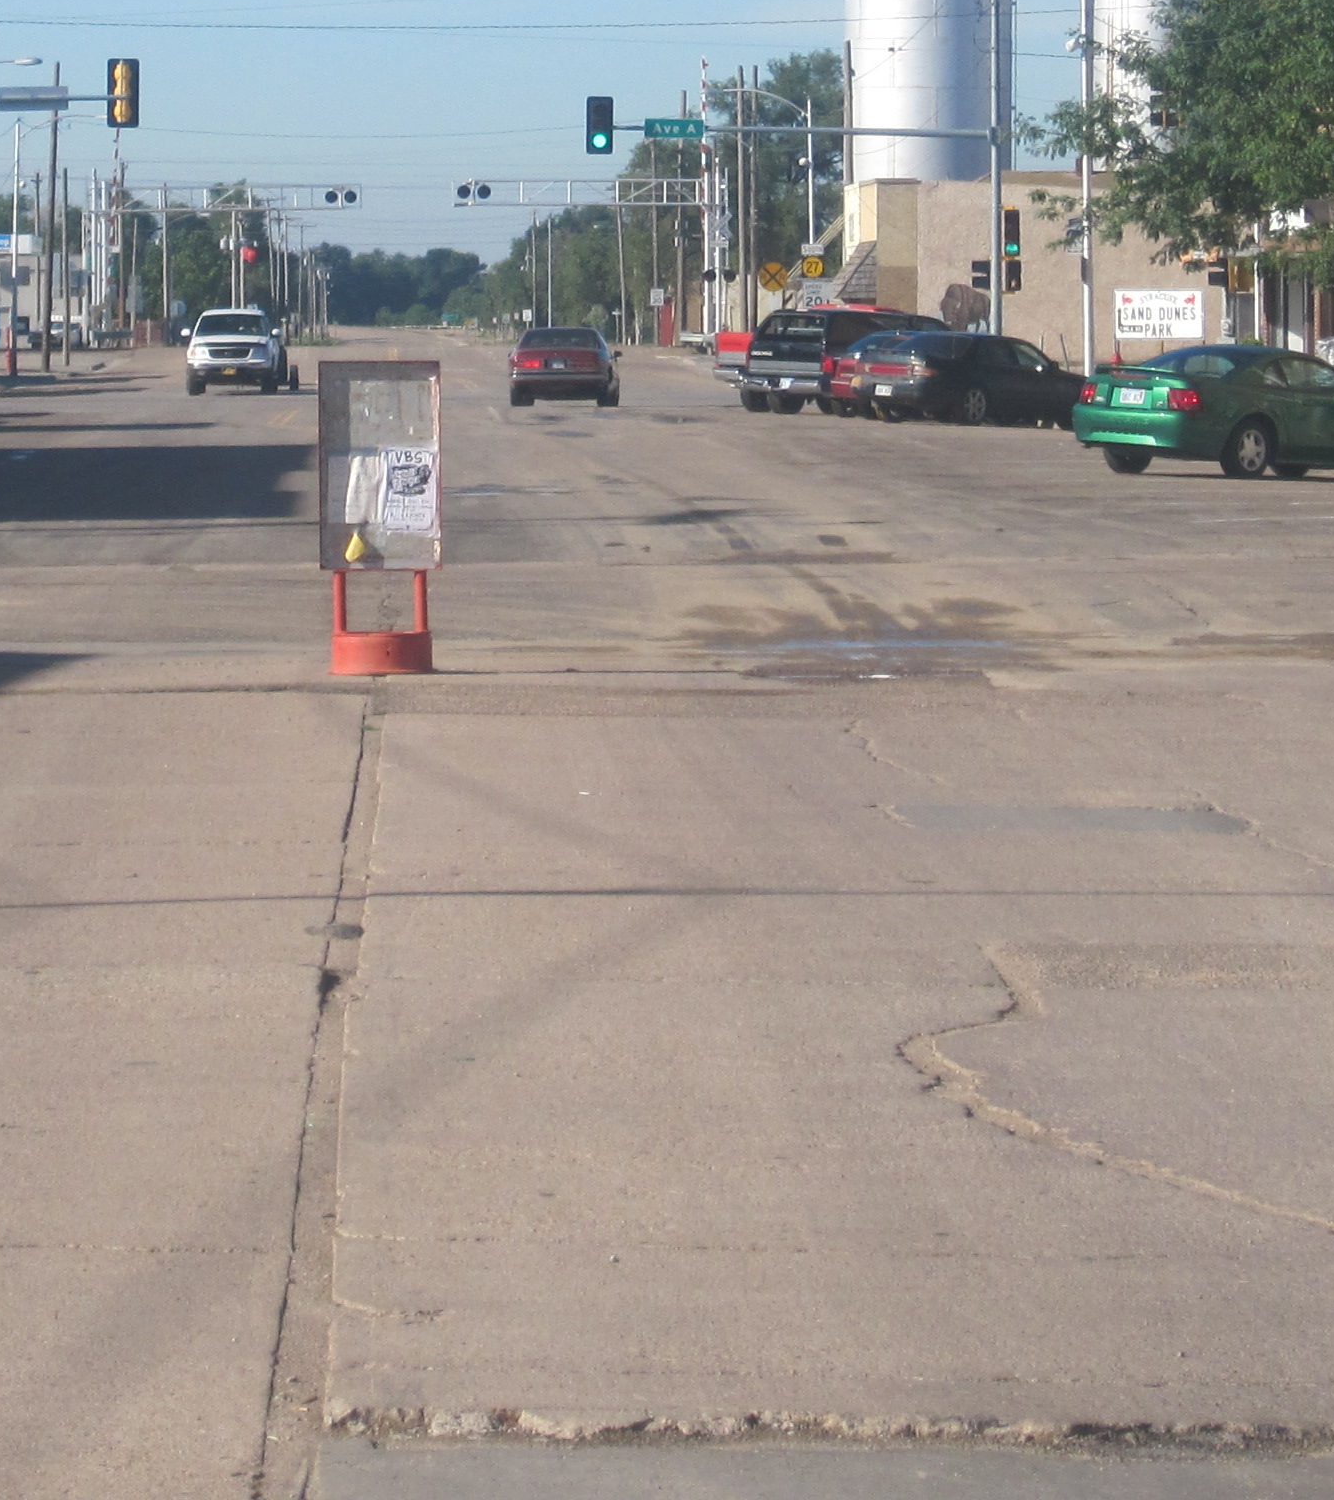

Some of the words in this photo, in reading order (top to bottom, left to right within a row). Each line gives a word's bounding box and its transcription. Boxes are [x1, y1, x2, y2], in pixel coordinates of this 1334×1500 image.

[653, 123, 680, 134] Ave
[687, 124, 696, 134] A
[806, 261, 819, 273] 27
[805, 297, 823, 307] 20
[1123, 307, 1153, 321] SAND
[1159, 307, 1196, 321] DUNES
[1144, 323, 1173, 337] PARK
[394, 450, 424, 464] VBS
